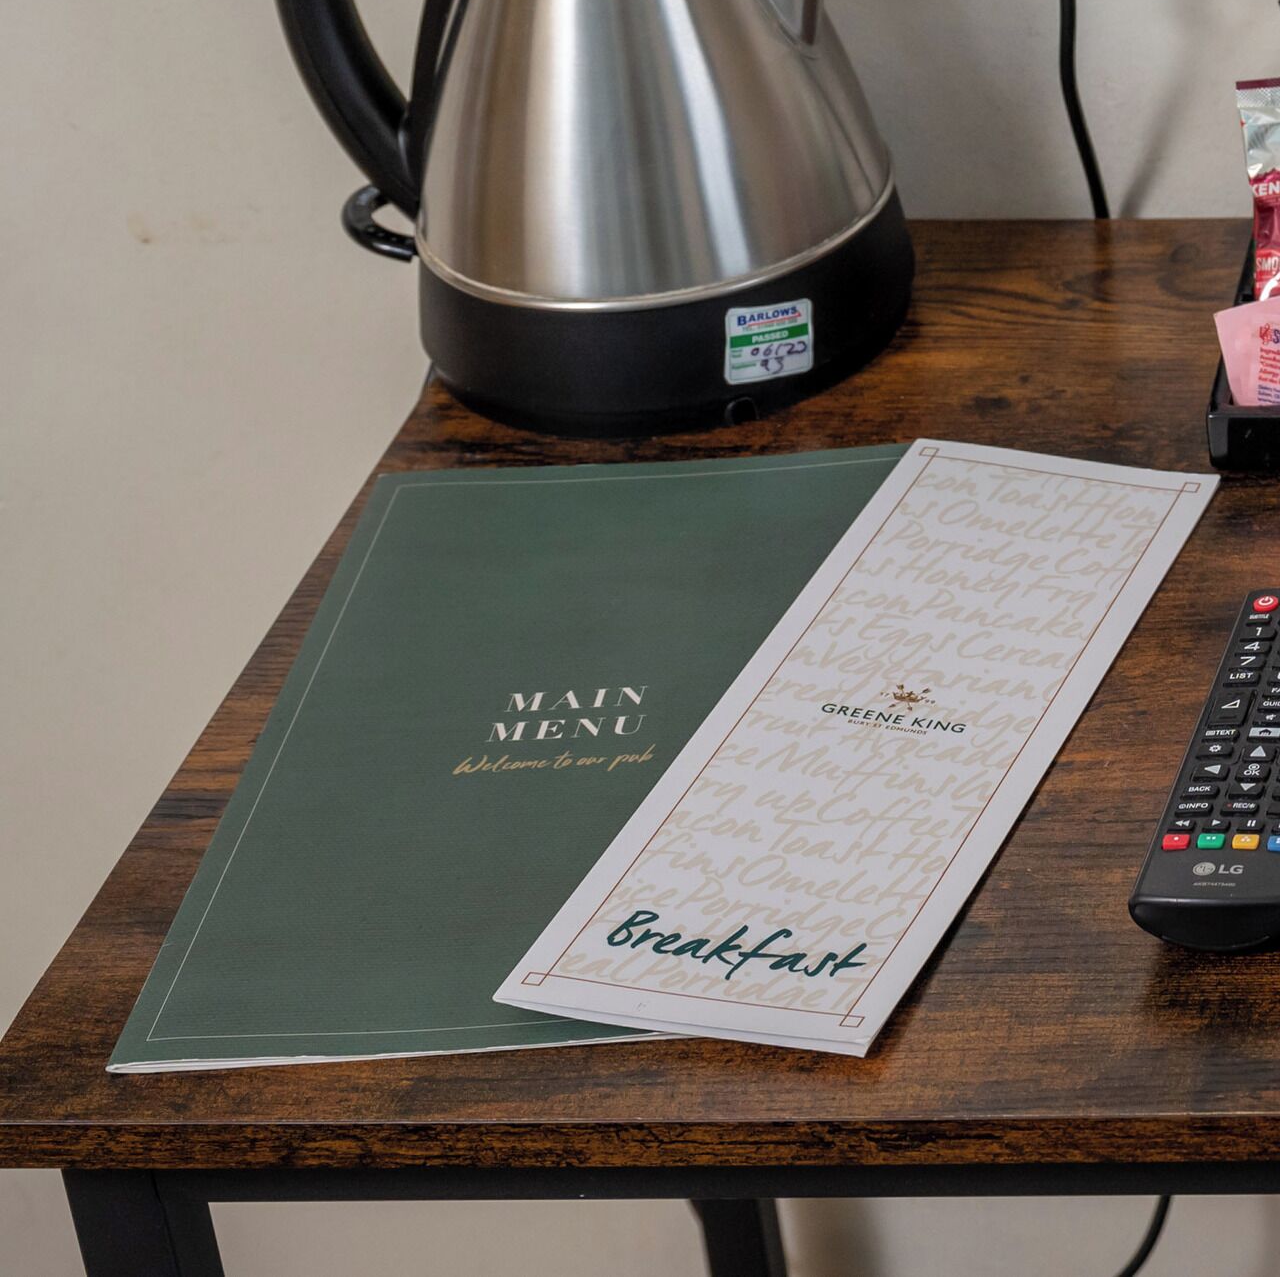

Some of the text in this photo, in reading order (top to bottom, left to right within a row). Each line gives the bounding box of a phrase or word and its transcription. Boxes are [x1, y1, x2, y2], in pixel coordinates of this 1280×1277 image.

[737, 306, 798, 327] BARLOWS
[751, 330, 789, 344] PASSED
[1256, 627, 1262, 636] 1
[1244, 642, 1260, 651] 4
[1240, 656, 1256, 665] 7
[1230, 672, 1253, 680] LIST
[503, 685, 648, 712] MAIN
[821, 702, 966, 734] GREENE KING
[847, 718, 871, 728] BURY
[885, 724, 928, 736] EDMUNDS
[485, 714, 648, 743] MENU
[452, 743, 656, 776] Welcome to our pub
[1218, 864, 1244, 875] LG
[606, 909, 868, 981] Breakfast
